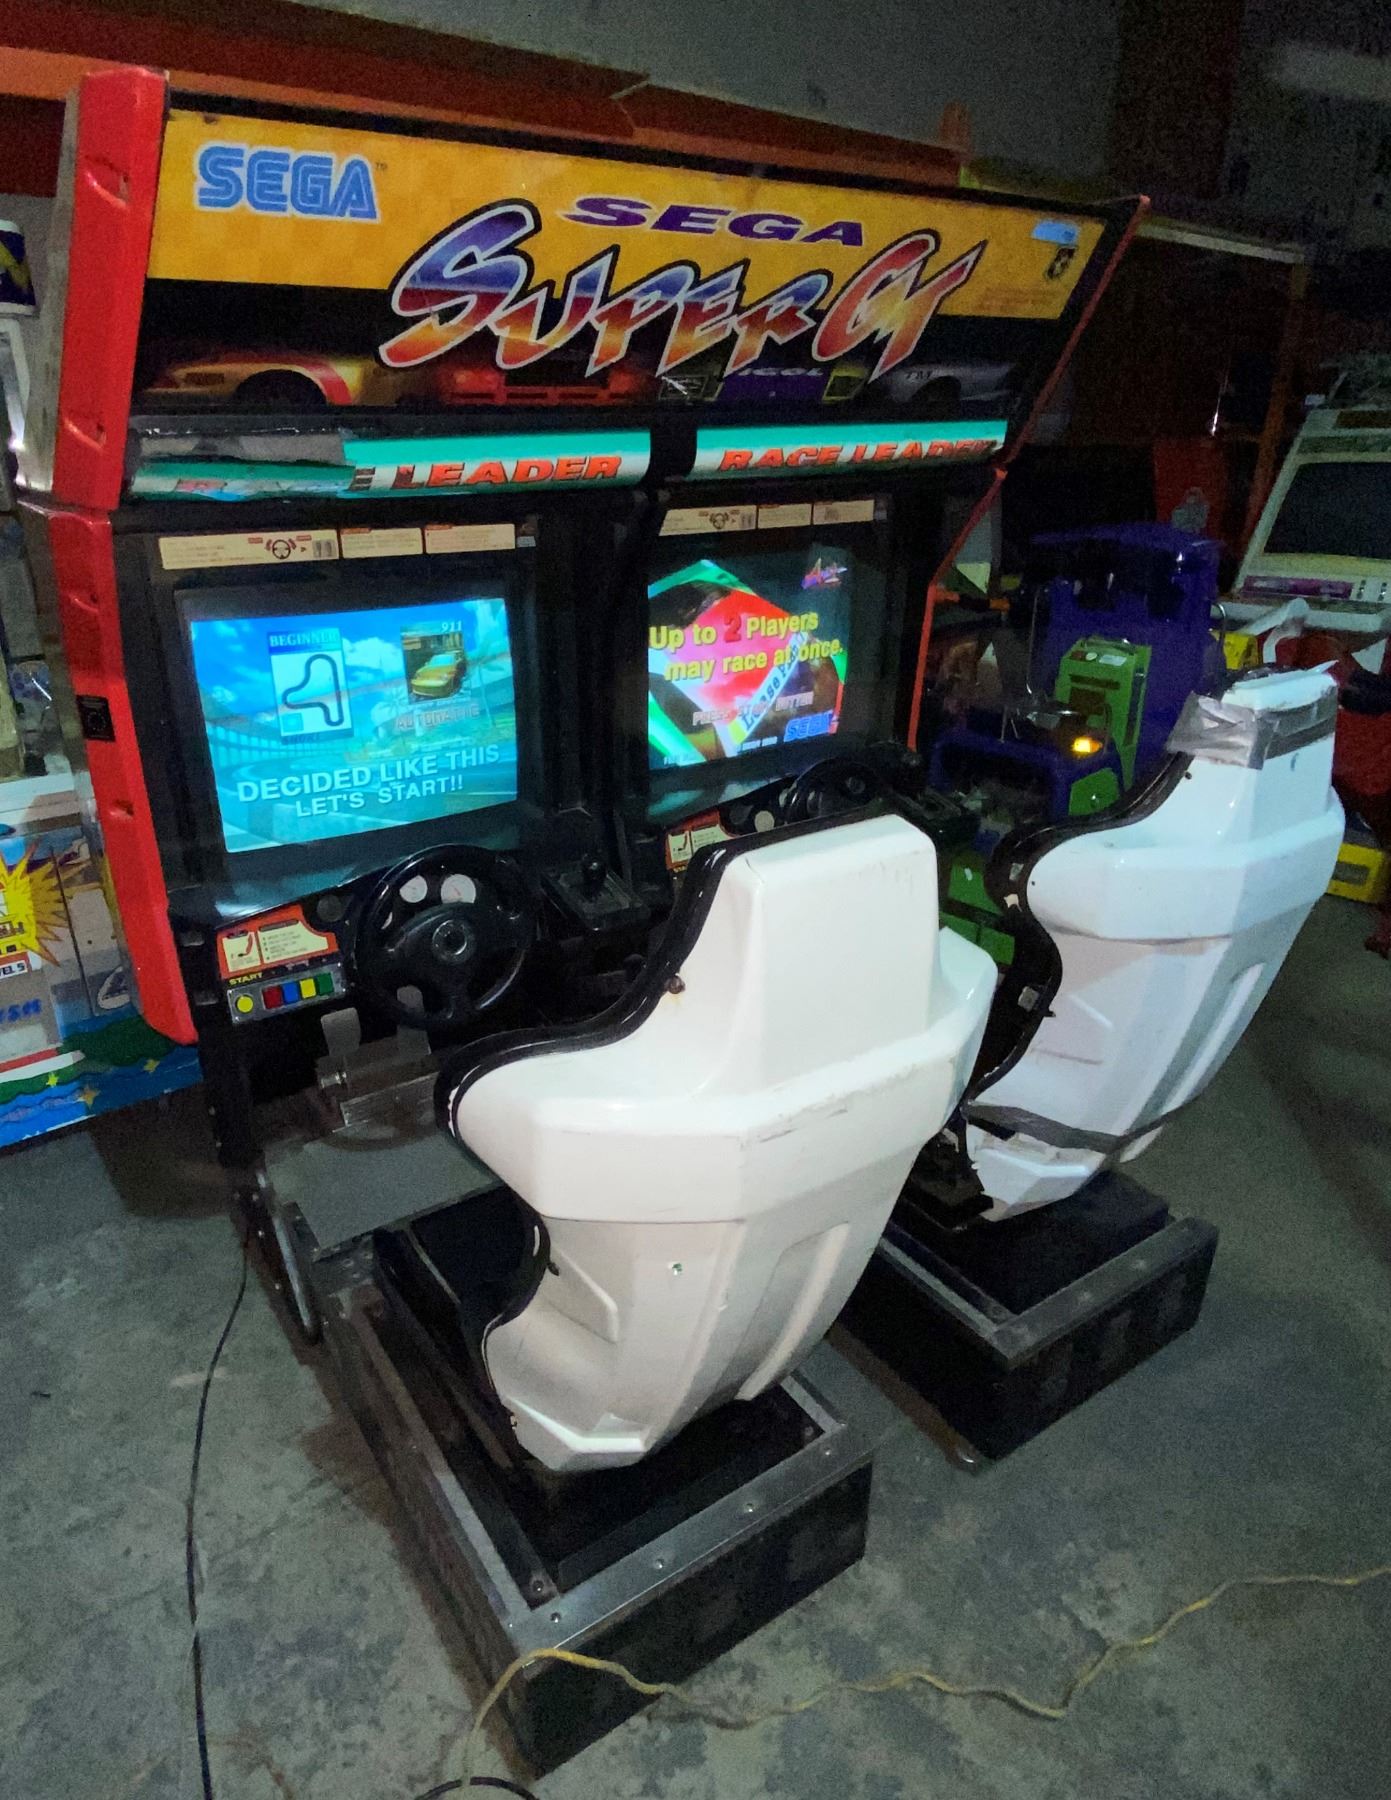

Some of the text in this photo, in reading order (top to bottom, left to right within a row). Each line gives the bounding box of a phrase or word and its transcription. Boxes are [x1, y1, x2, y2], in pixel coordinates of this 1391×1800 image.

[196, 143, 380, 221] SEGA
[563, 197, 865, 247] SEGA
[377, 199, 833, 378] SUPER
[390, 455, 623, 490] LEADER
[717, 439, 998, 472] RACE LEADER
[441, 620, 463, 633] 911
[649, 611, 819, 653] Up to 2 Players
[665, 655, 715, 683] may
[722, 650, 768, 675] race
[798, 638, 843, 663] once.
[237, 744, 500, 802] DECIDED LIKE THIS
[296, 776, 464, 819] LET'S START!!
[228, 971, 263, 986] START
